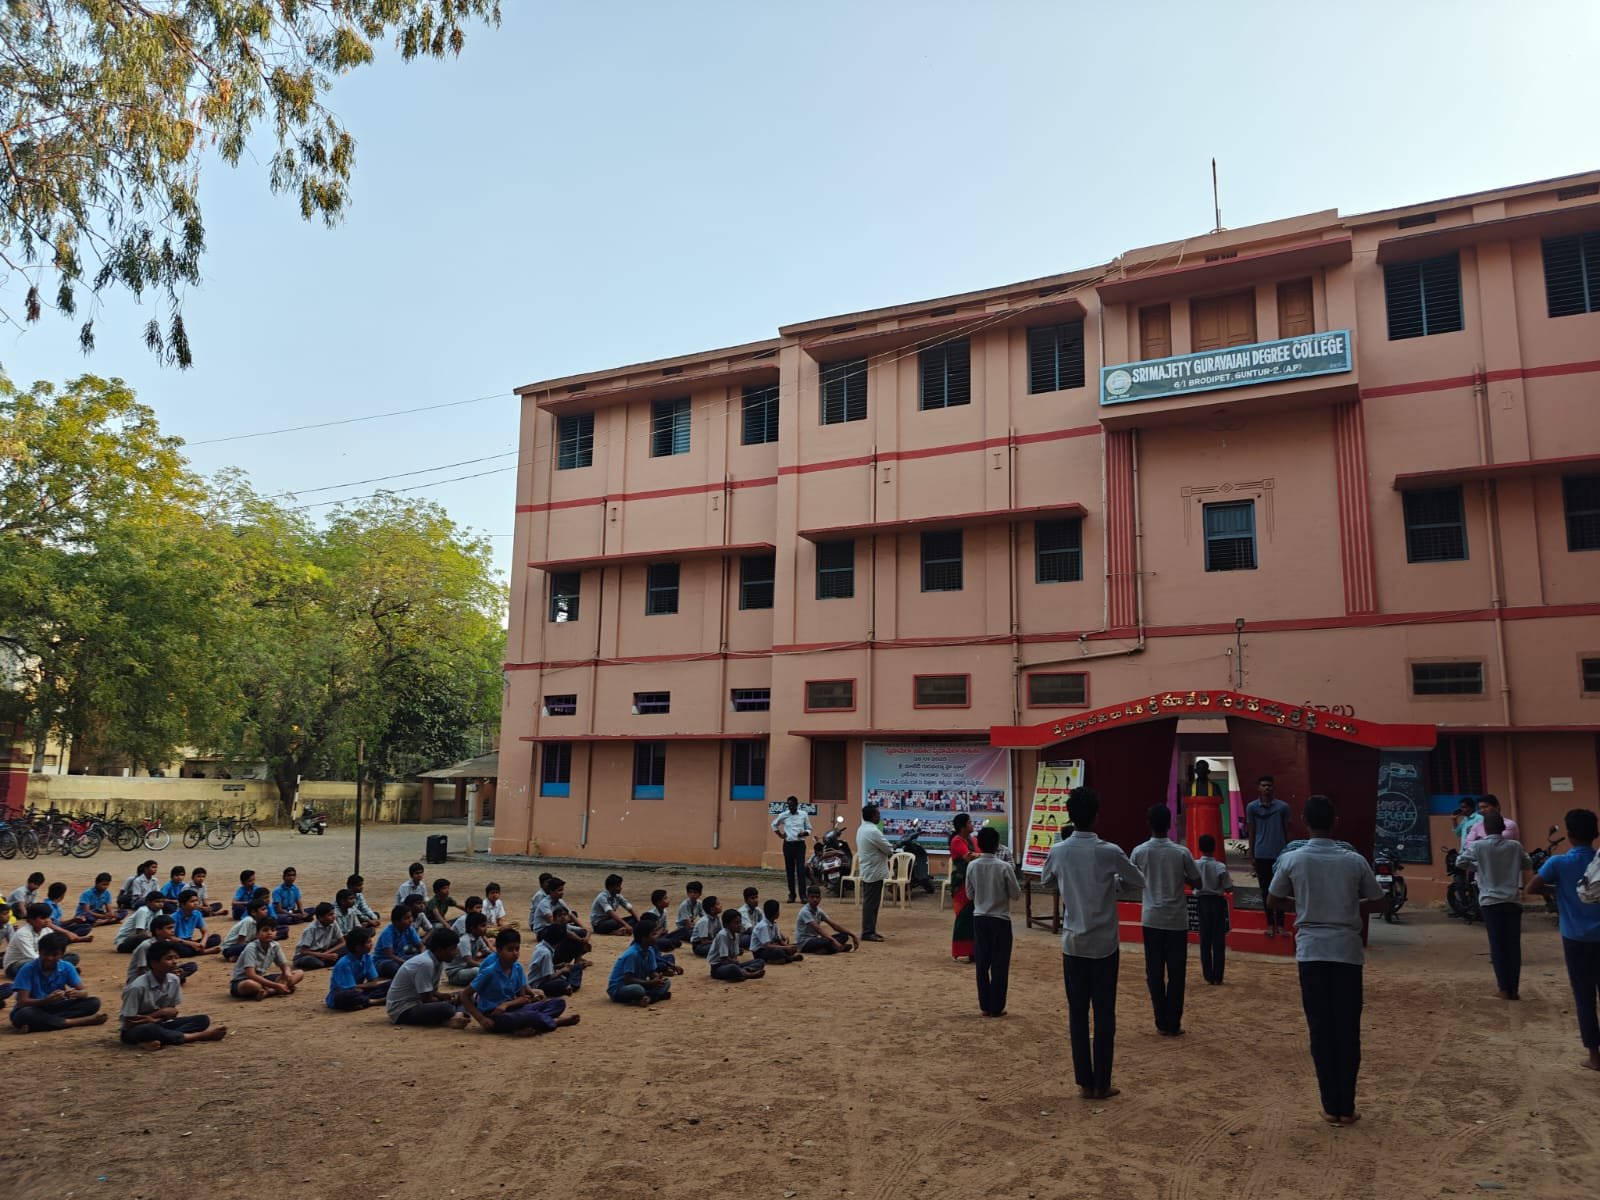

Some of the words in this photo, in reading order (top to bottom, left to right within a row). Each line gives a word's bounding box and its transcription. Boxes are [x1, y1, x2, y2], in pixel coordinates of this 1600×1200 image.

[1193, 351, 1250, 374] GURAVAIAH
[1251, 344, 1290, 365] DEGREE
[1292, 336, 1343, 359] COLLEGE
[1173, 380, 1186, 388] 6/1
